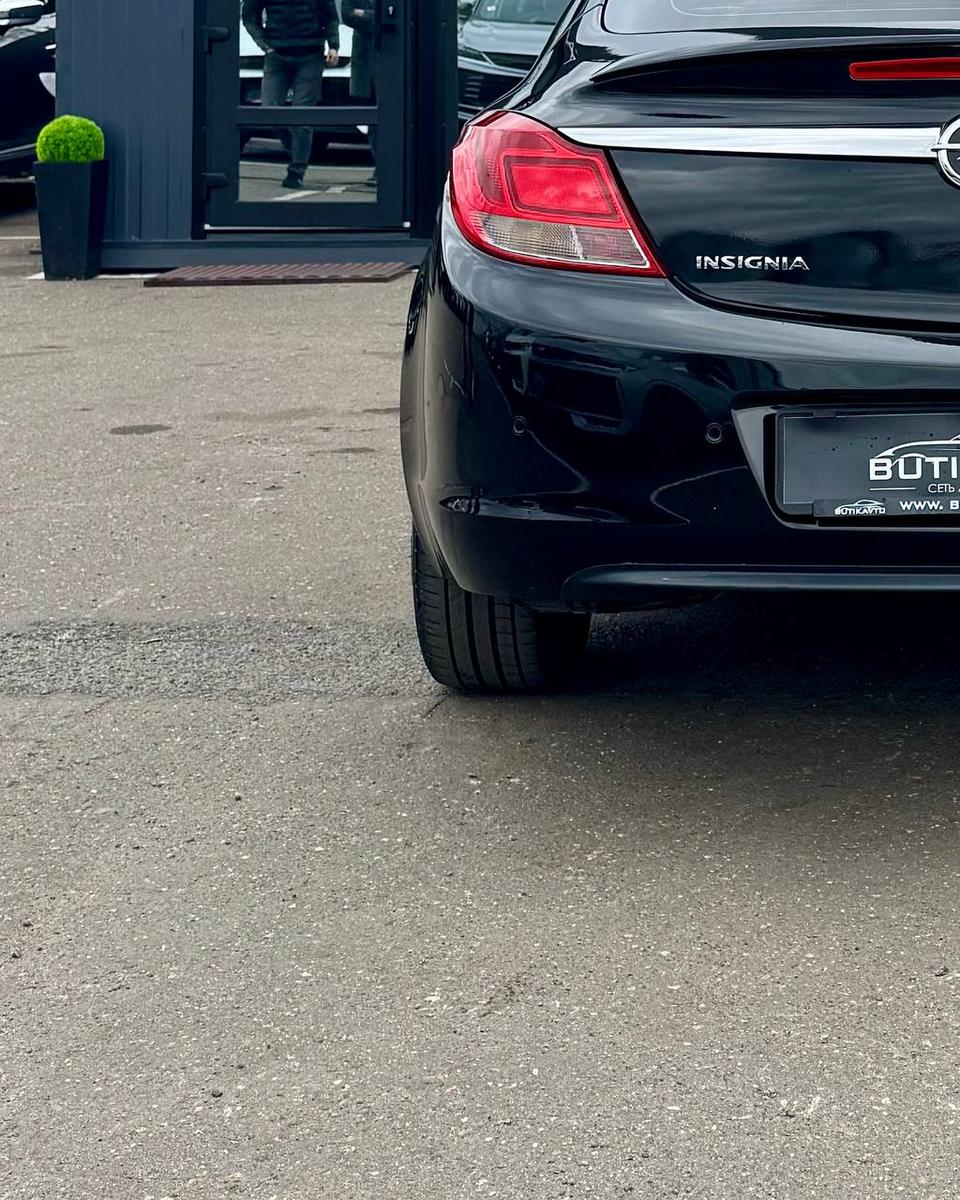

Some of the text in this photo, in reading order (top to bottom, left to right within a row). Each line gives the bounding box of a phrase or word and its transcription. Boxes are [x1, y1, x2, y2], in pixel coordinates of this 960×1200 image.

[695, 255, 810, 271] INSIGNIA
[928, 483, 955, 494] СЕТЬ
[835, 507, 886, 515] BUTIKAVTO
